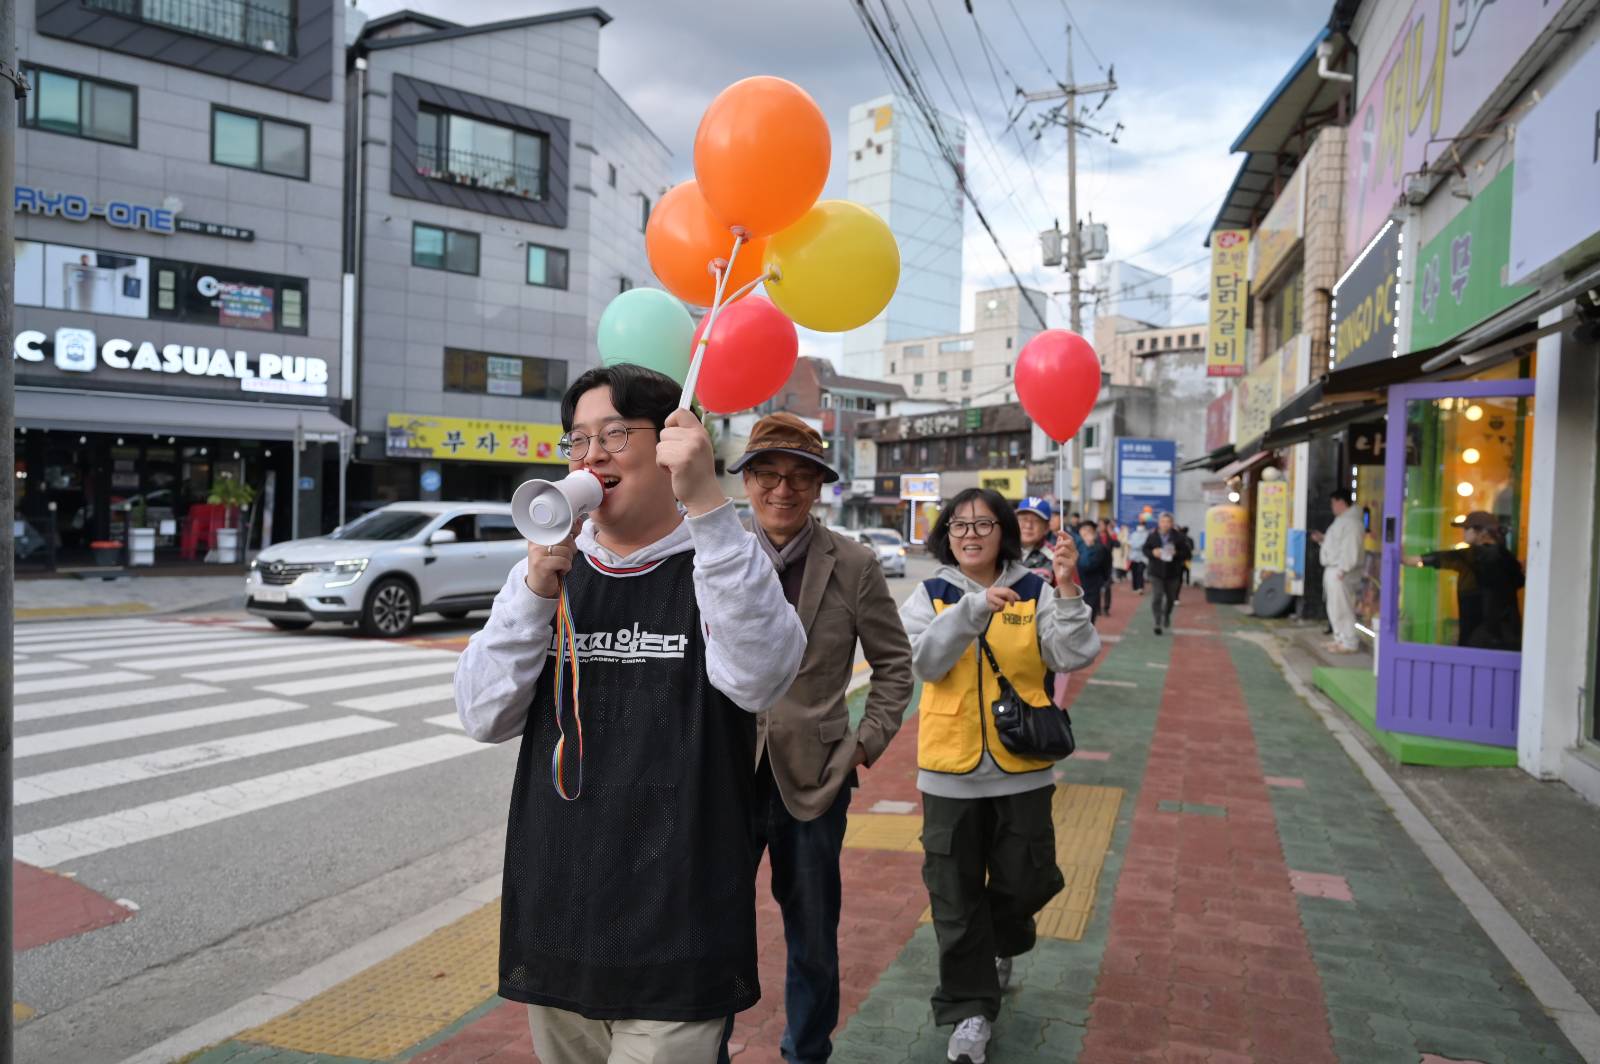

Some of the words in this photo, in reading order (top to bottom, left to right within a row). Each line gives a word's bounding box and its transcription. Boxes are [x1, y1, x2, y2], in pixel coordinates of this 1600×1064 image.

[15, 186, 174, 231] RYO-ONE
[1215, 271, 1243, 362] 닭갈비
[1375, 273, 1394, 333] PC
[14, 330, 47, 361] C
[102, 338, 254, 378] CASUAL
[259, 353, 328, 384] PUB
[1029, 496, 1042, 508] W
[614, 621, 689, 653] 않는다
